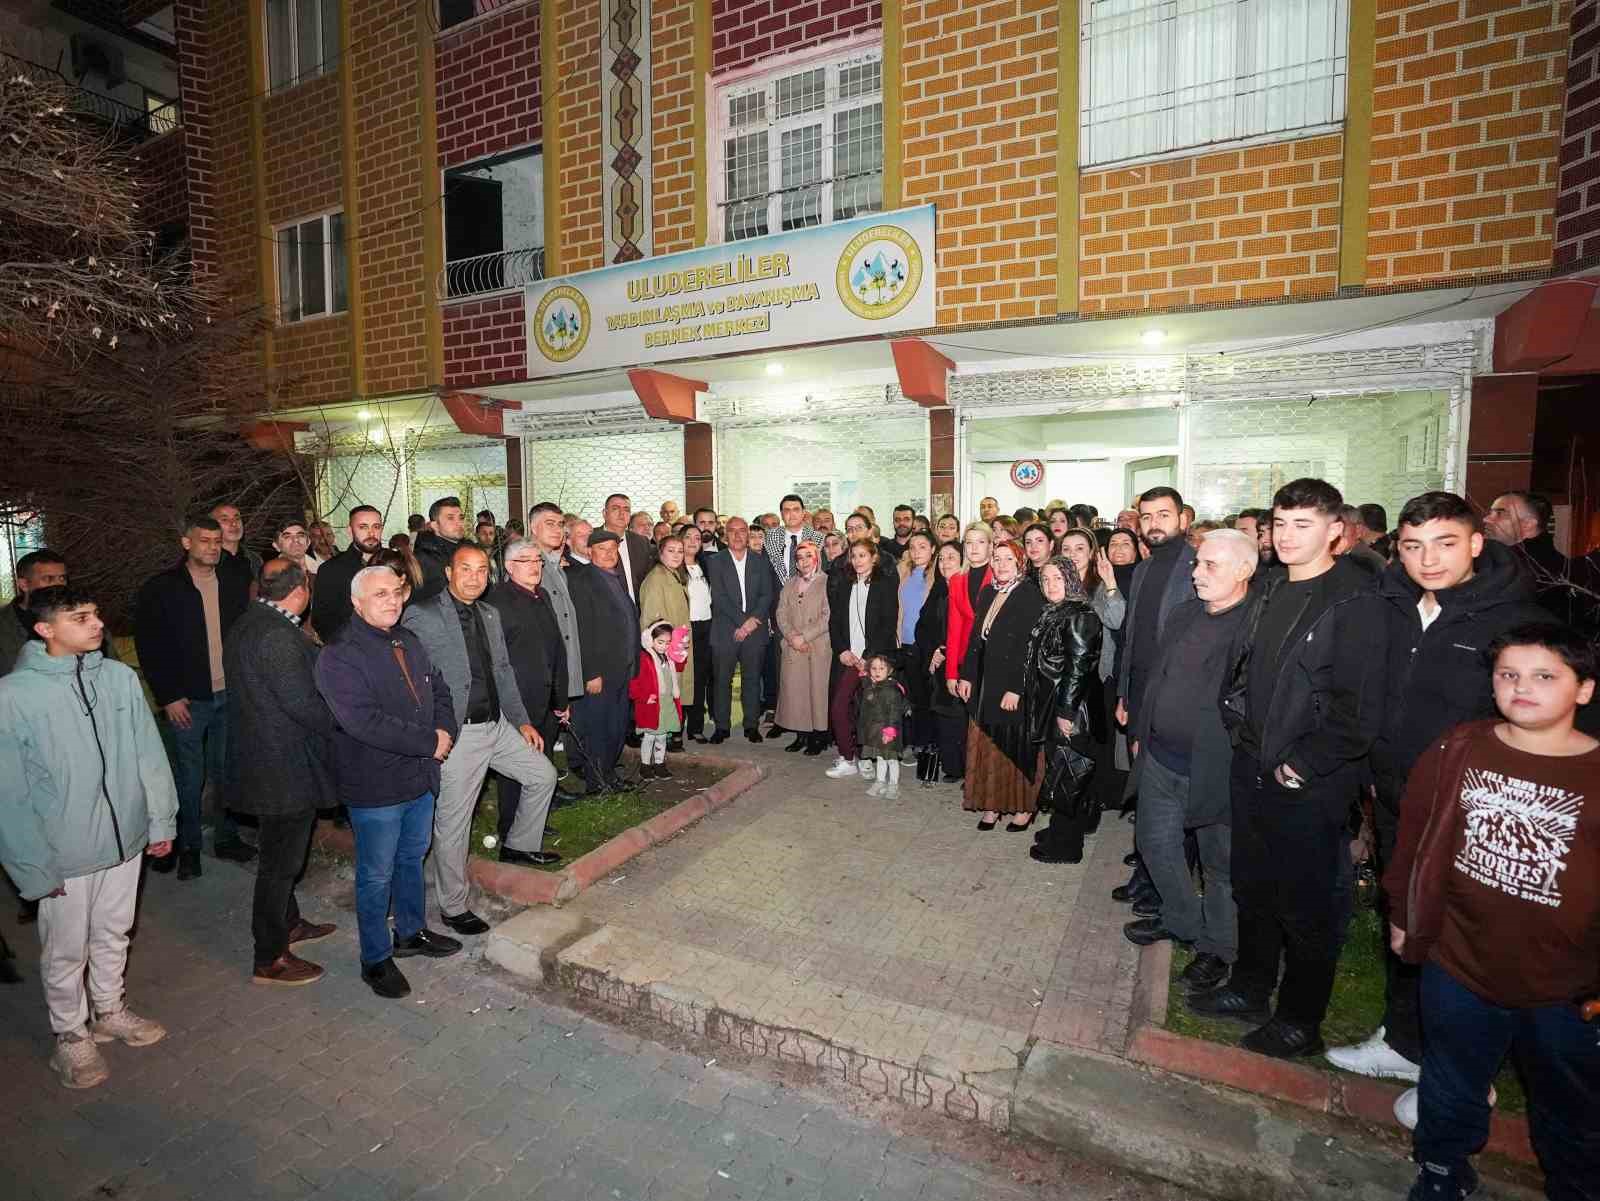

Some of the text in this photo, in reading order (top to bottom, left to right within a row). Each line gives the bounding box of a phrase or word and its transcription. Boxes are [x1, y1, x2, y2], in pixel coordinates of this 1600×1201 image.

[626, 252, 790, 302] ULUDERELİLER
[1469, 846, 1543, 885] STORIES
[1480, 865, 1520, 887] TO TELL
[1501, 884, 1518, 896] TO
[1520, 891, 1561, 908] SHOW
